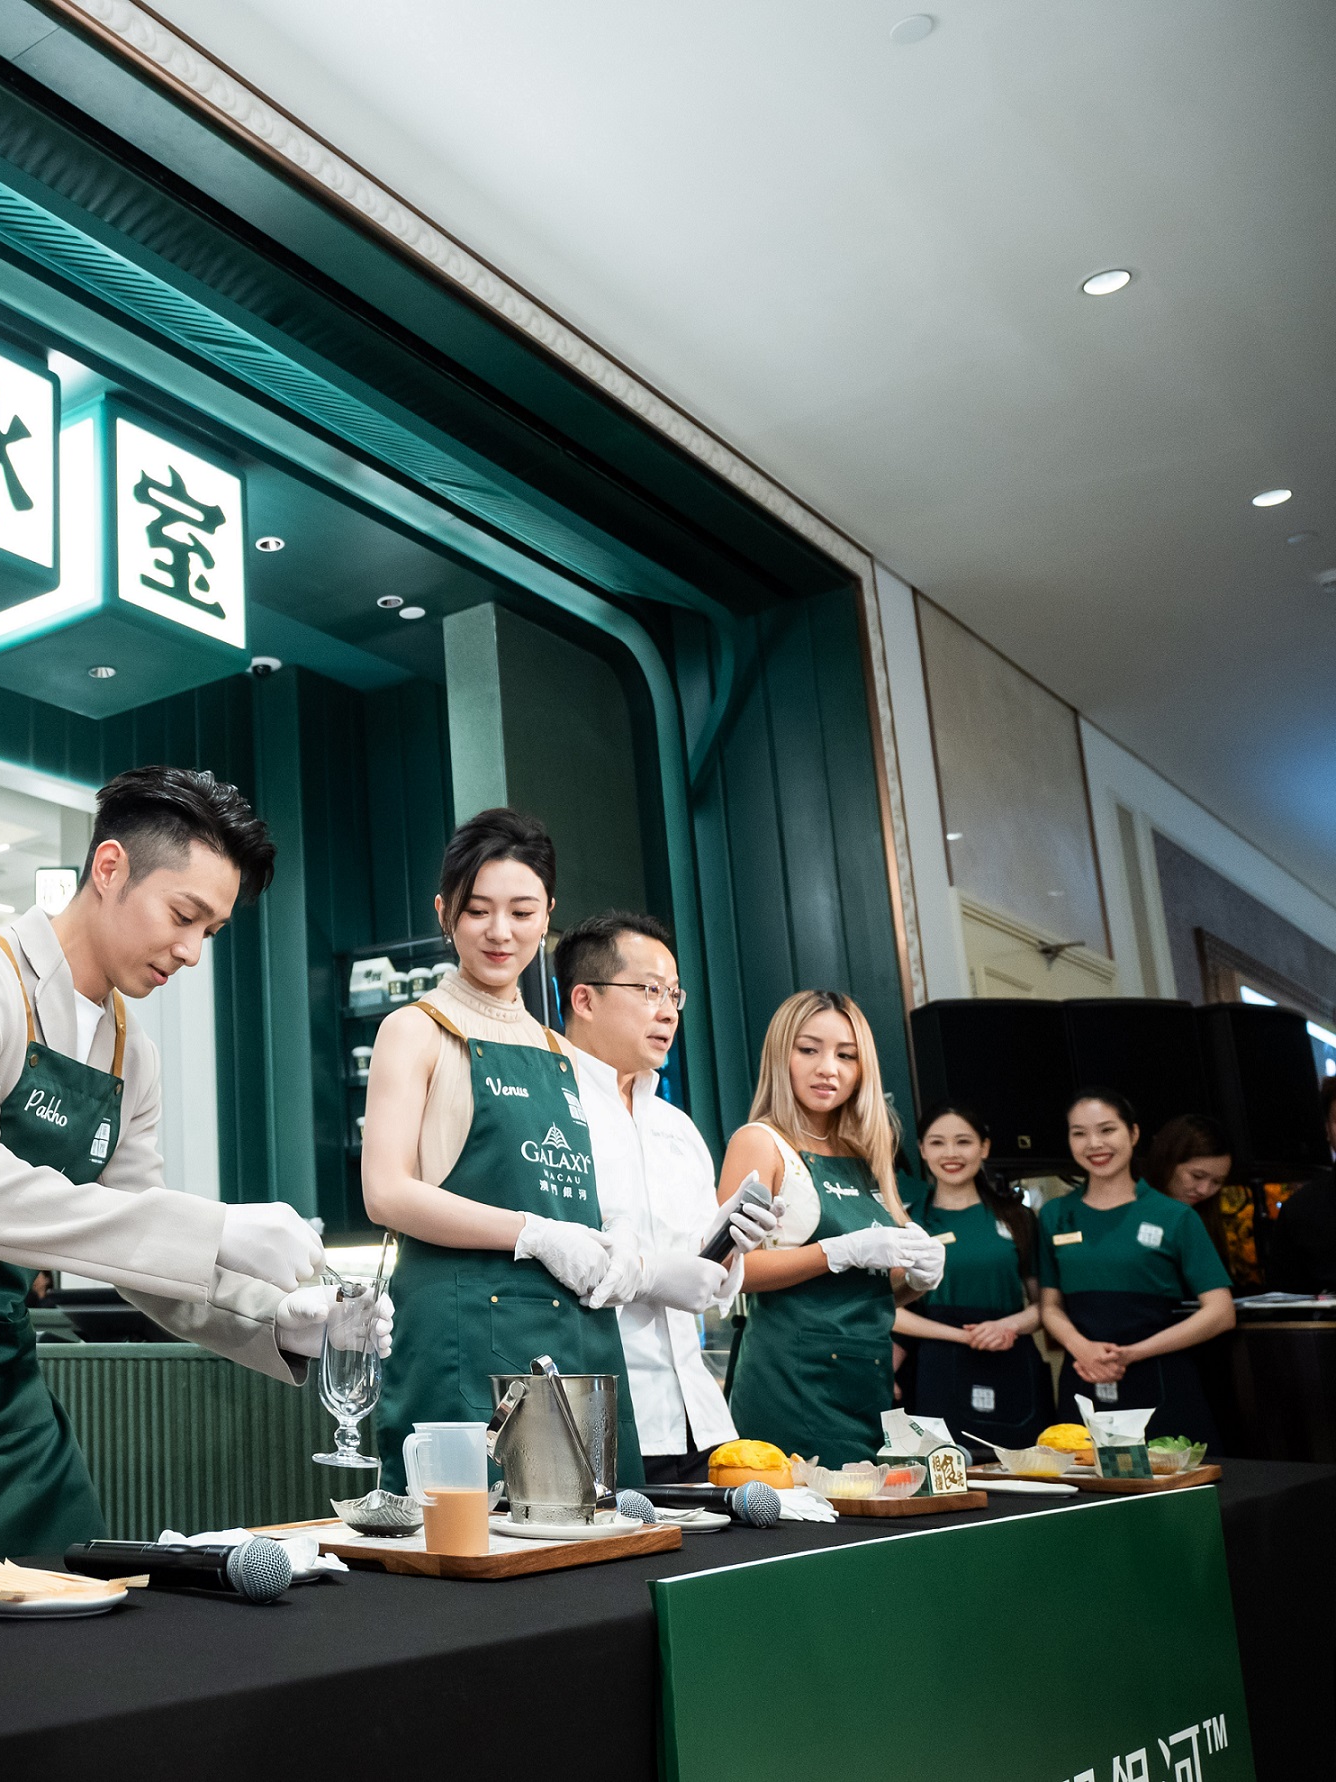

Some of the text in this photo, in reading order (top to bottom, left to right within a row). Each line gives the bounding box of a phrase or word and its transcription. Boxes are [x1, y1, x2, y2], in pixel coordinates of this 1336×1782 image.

[485, 1076, 530, 1098] Venus
[24, 1089, 68, 1127] Pakho
[521, 1140, 589, 1174] GALAXY
[543, 1169, 581, 1185] MACAU
